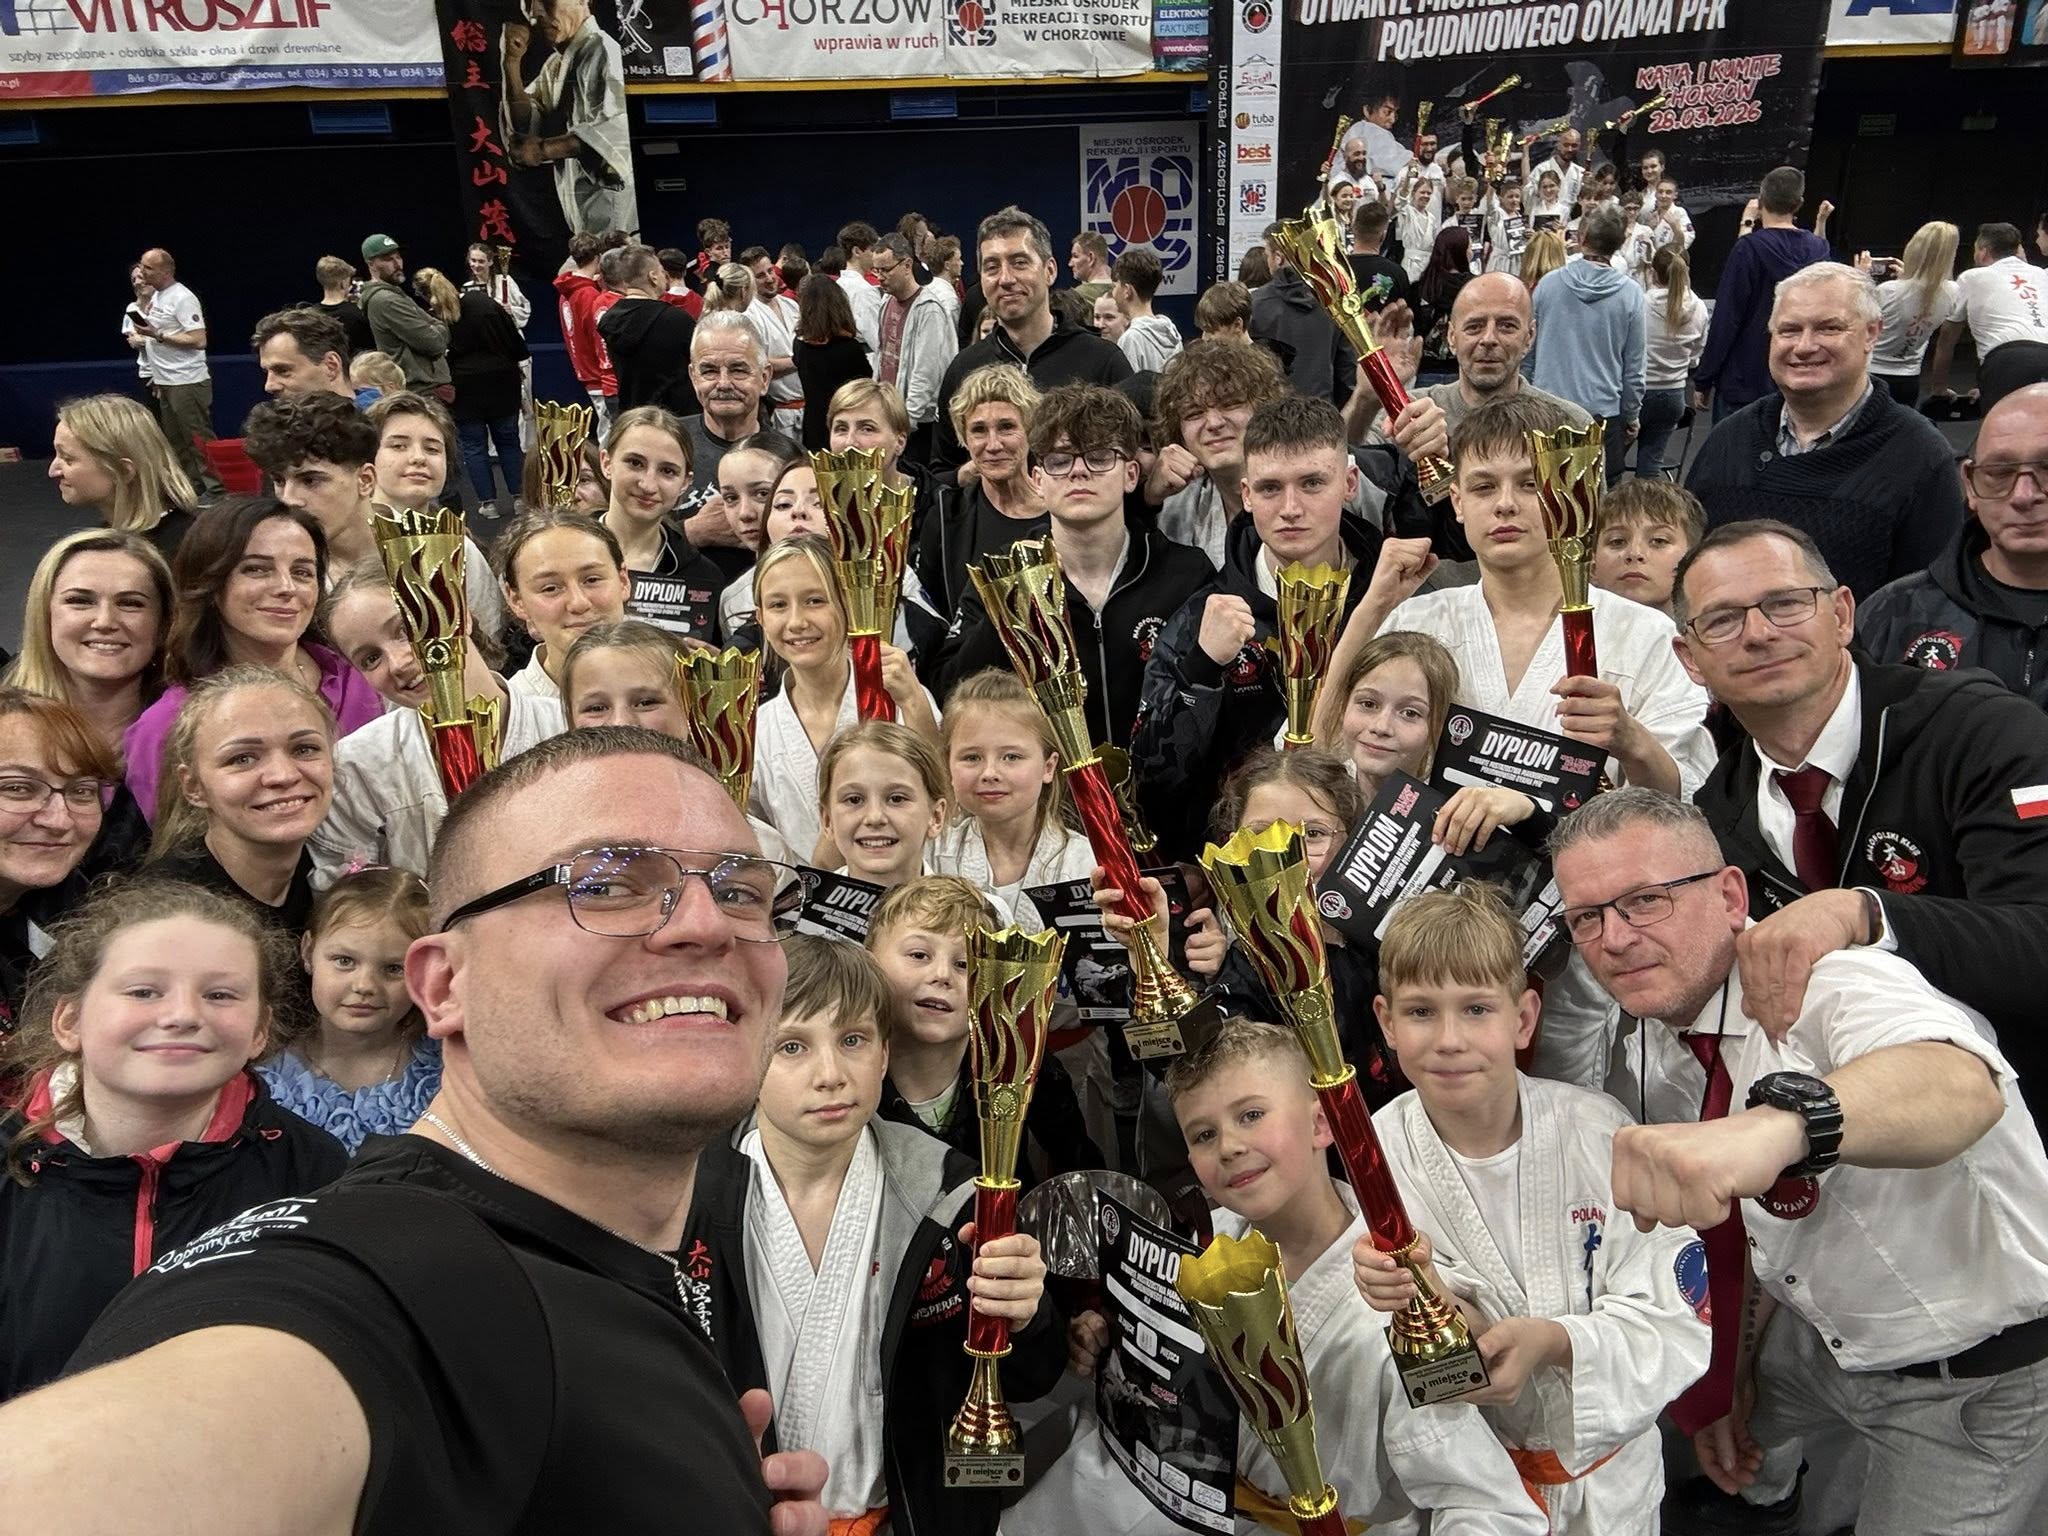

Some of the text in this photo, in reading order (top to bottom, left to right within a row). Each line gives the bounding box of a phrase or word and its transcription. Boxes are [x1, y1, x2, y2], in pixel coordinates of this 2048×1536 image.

[1002, 13, 1148, 26] REKREACJI I SPORTU
[1024, 30, 1126, 42] W CHORZOWIE
[1377, 3, 1579, 62] POŁUDNIOWEGO
[1581, 0, 1673, 42] OYAMA
[9, 51, 42, 62] szyby
[46, 48, 106, 61] zespolone
[119, 46, 166, 58] obróbka
[170, 45, 198, 57] szkła
[209, 45, 237, 56] okna
[248, 43, 280, 55] drzwi
[284, 42, 342, 53] drewniane
[814, 33, 939, 54] wprawia w ruch
[305, 69, 329, 80] (034)
[332, 68, 349, 79] 363
[352, 68, 364, 79] 32
[383, 67, 398, 78] fax
[401, 66, 424, 78] (034)
[630, 65, 651, 76] Maja
[653, 65, 665, 75] 56
[1636, 54, 1783, 90] KATA I KUMITE
[1252, 114, 1274, 123] tuba
[1648, 100, 1762, 133] 28.03.2026
[1094, 136, 1185, 147] MIEJSKI OŚRODEK
[1086, 147, 1143, 156] REKREACJI
[1150, 145, 1191, 154] SPORTU
[1237, 144, 1272, 158] best
[634, 581, 687, 603] DYPLOM
[1480, 731, 1559, 771] DYPLOM
[1344, 813, 1404, 893] DYPLOM
[825, 885, 877, 915] DYPL
[1142, 1037, 1171, 1047] miejsce
[1773, 1195, 1811, 1212] OYAMA
[1571, 1207, 1606, 1227] POLAN
[942, 1237, 953, 1251] UB
[1127, 1231, 1180, 1284] DYPLO
[1429, 1370, 1469, 1388] miejsce
[973, 1468, 1003, 1476] miejsce
